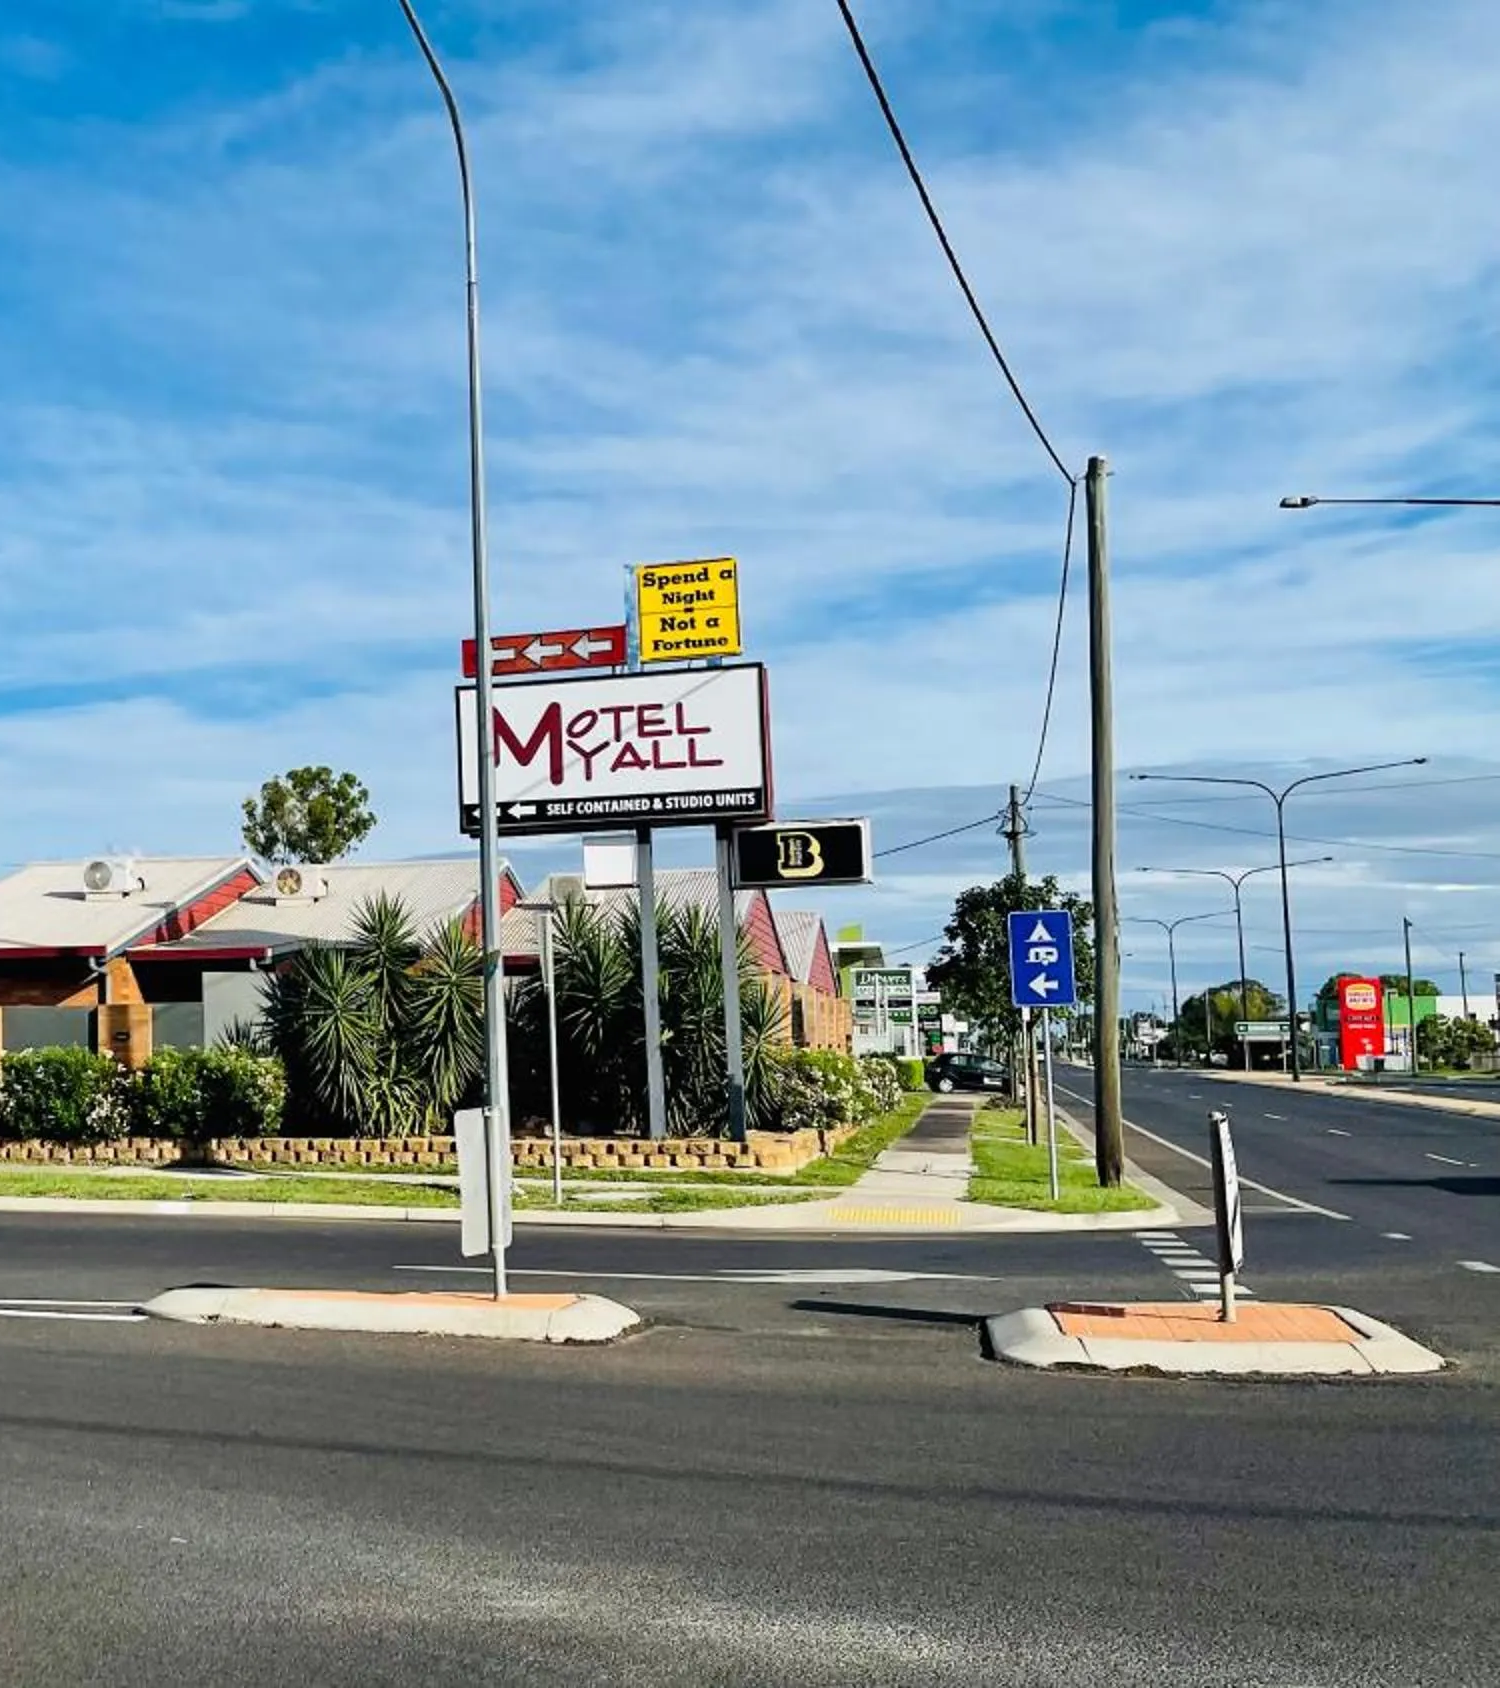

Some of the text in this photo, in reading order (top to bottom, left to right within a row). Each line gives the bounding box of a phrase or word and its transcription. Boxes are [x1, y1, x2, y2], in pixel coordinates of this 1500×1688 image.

[643, 567, 733, 590] Spend a
[662, 590, 715, 604] Night
[660, 617, 719, 632] Not a
[652, 637, 729, 652] Fortune
[546, 792, 756, 817] SELF CONTAINED & STUDIO UNITS
[777, 831, 824, 878] B
